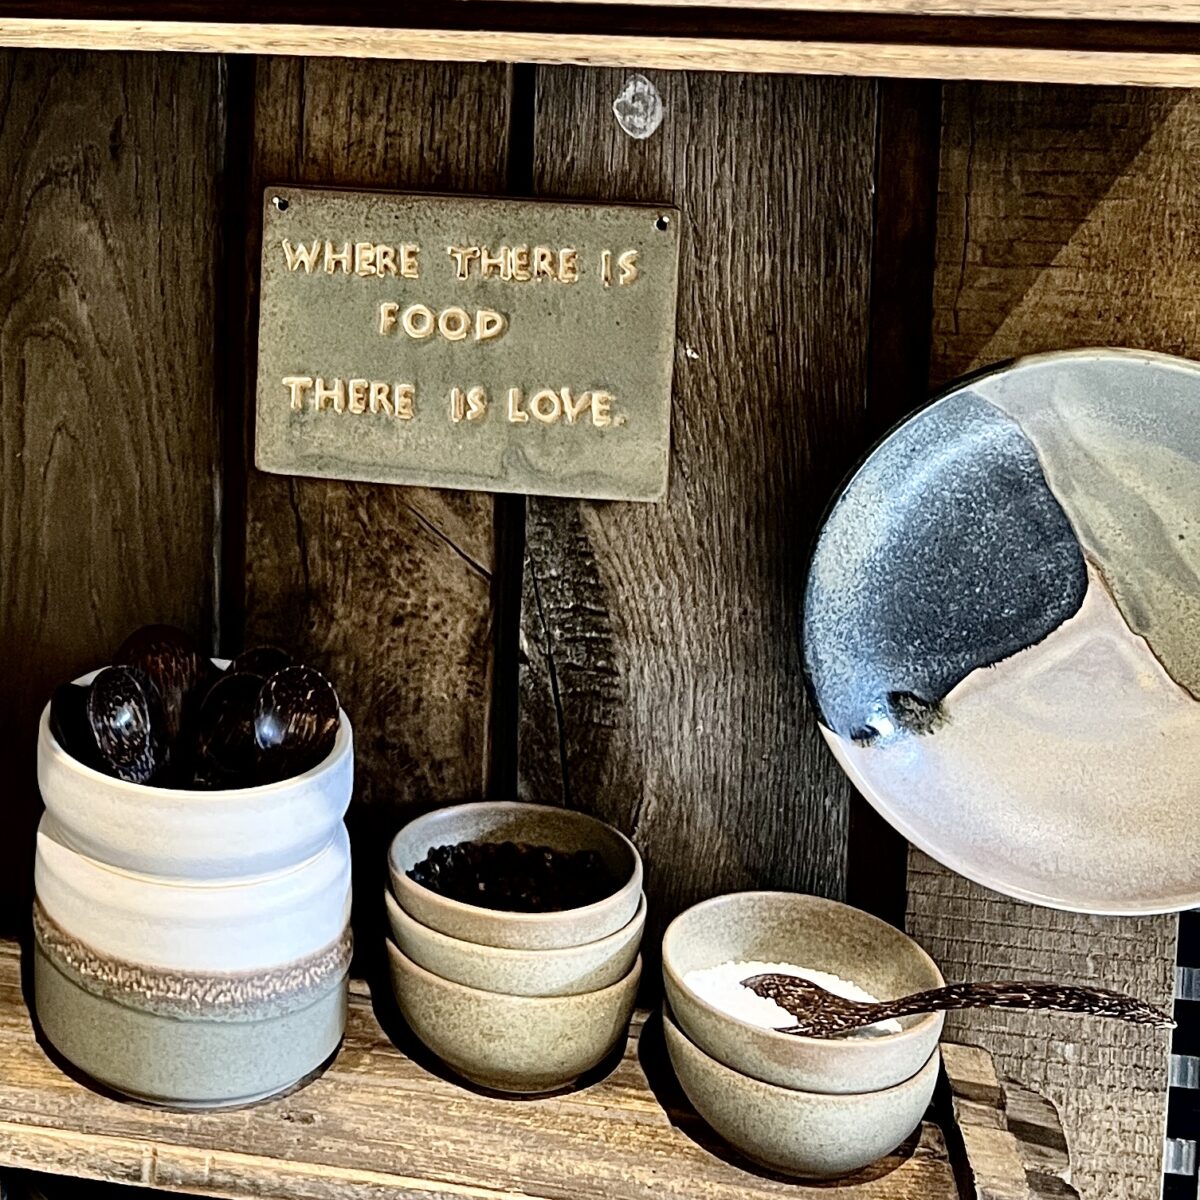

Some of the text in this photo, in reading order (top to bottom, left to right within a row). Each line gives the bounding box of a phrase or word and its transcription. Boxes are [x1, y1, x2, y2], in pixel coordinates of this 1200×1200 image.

[281, 238, 640, 287] WHERE THERE IS
[379, 301, 508, 341] FOOD
[281, 376, 626, 427] THERE IS LOVE.
